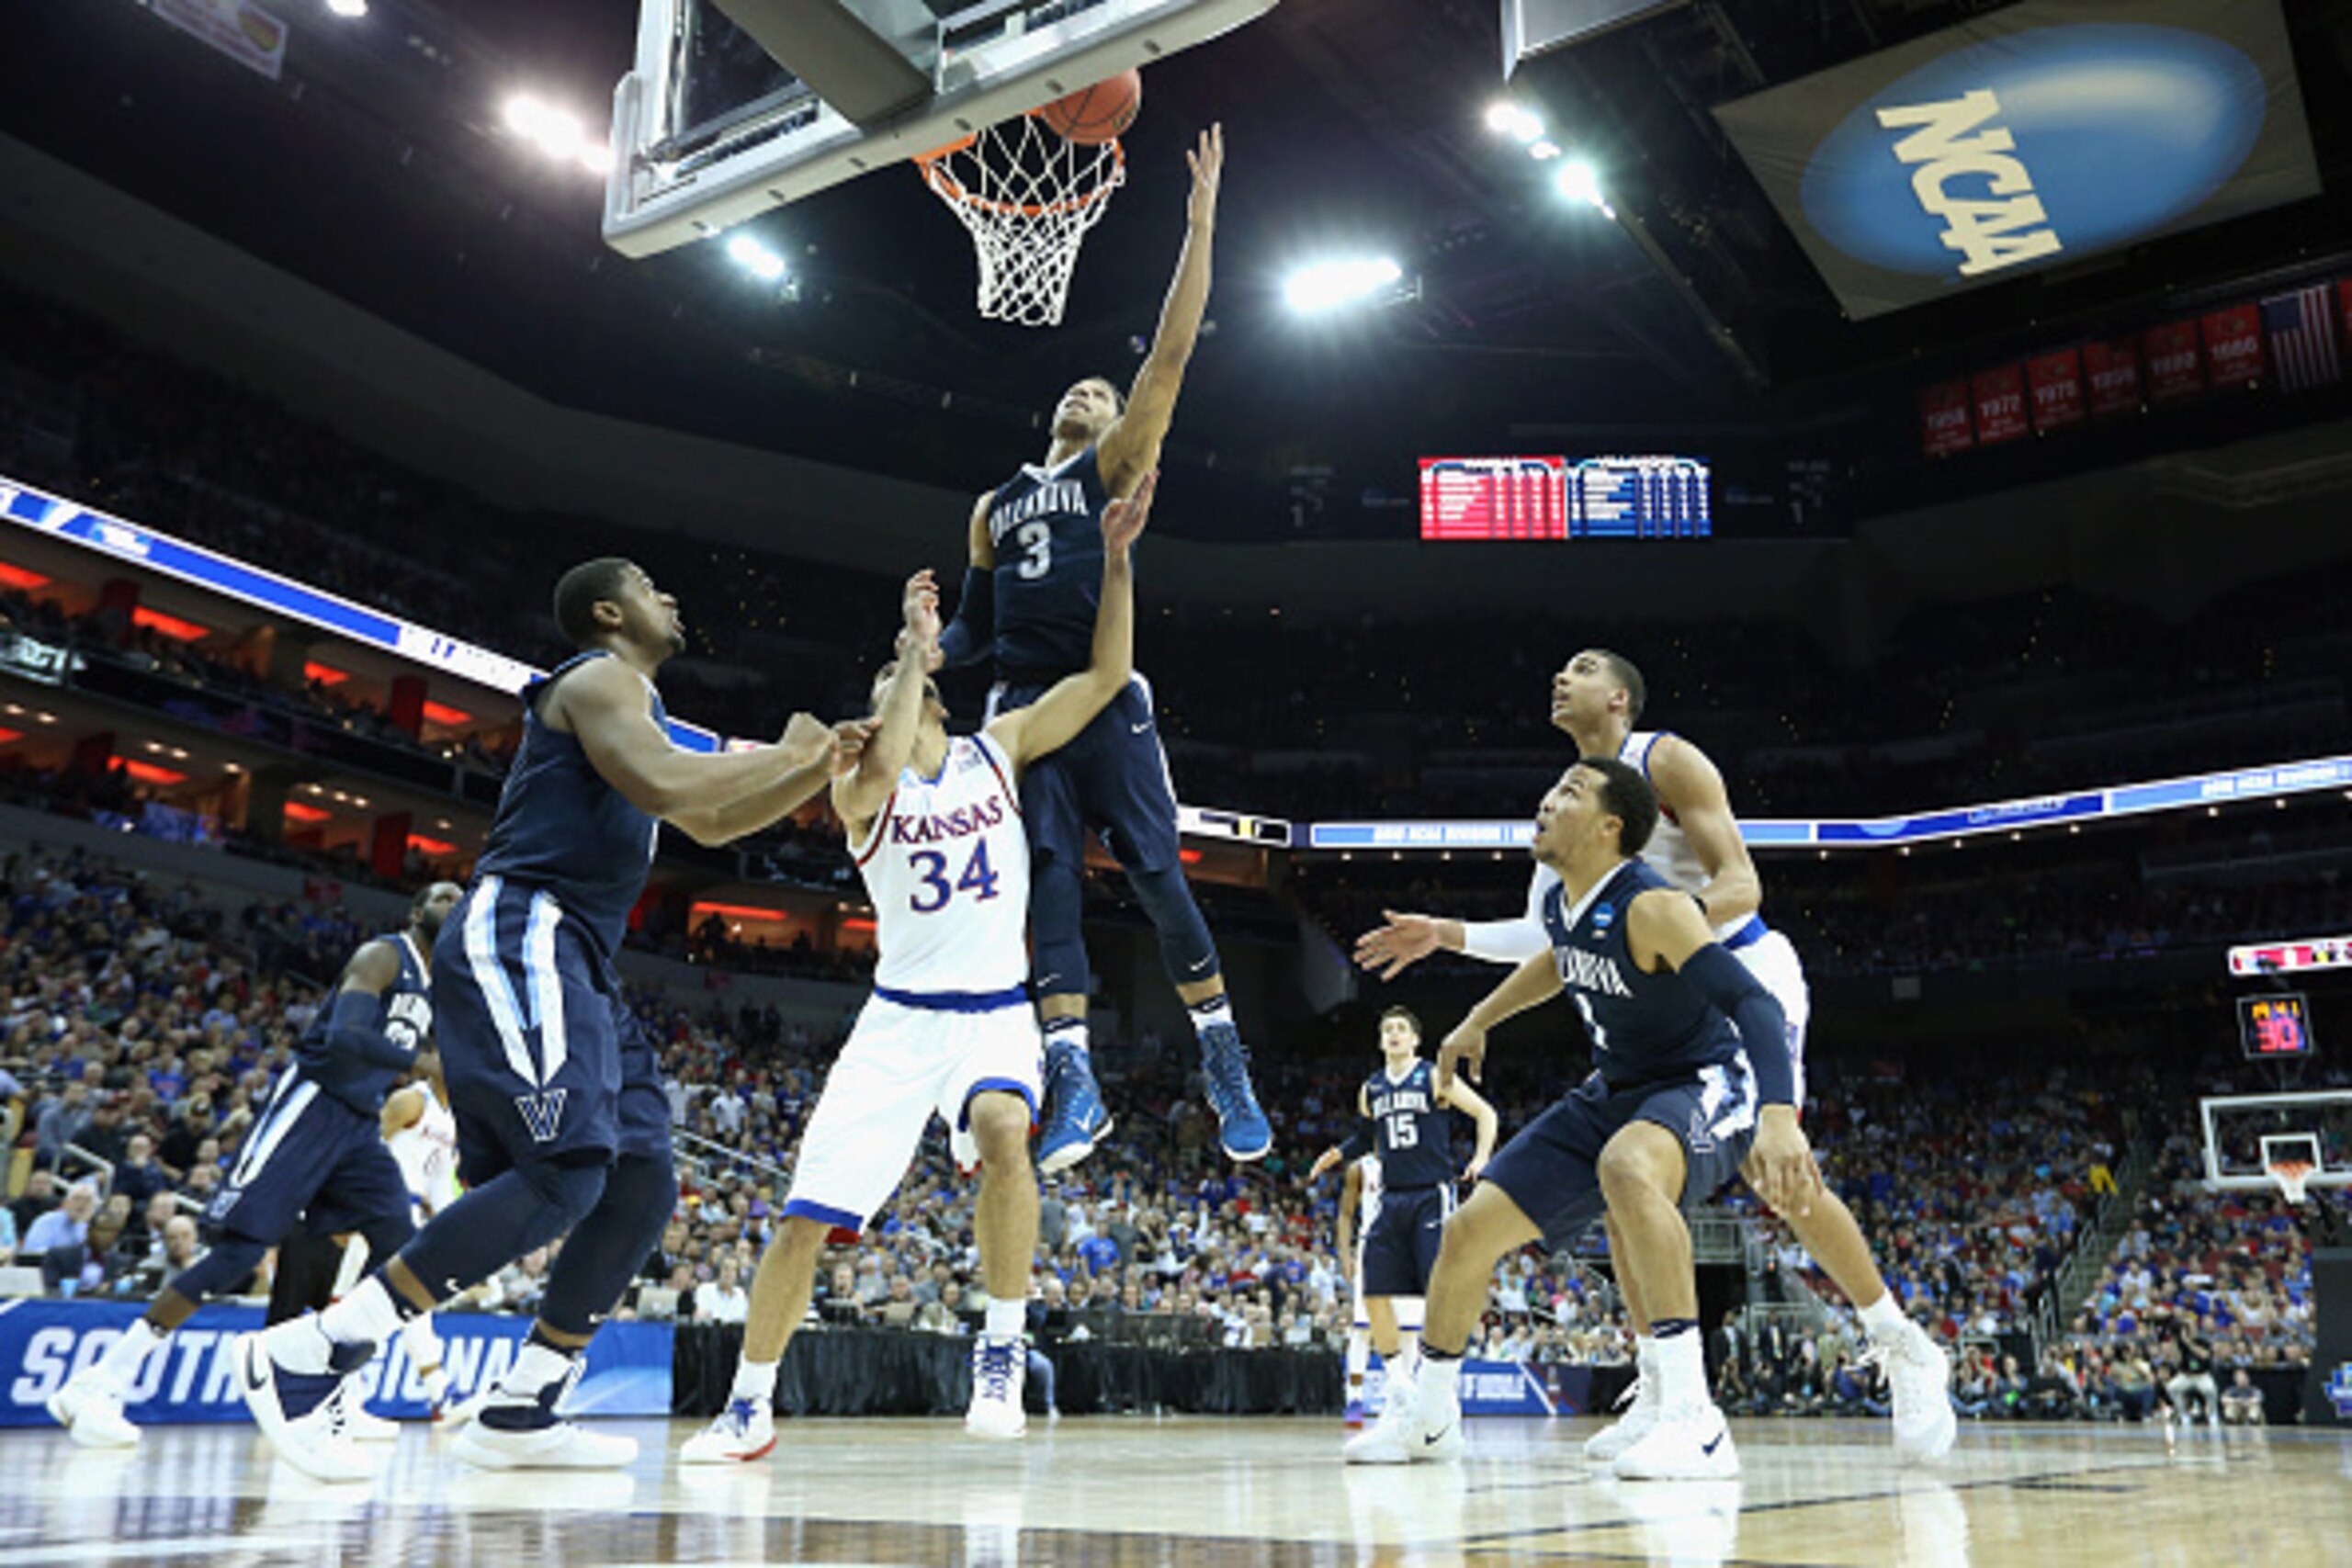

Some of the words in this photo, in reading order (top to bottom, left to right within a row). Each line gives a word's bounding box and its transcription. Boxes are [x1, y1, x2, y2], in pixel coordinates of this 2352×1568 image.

[1876, 87, 2064, 275] NCAA
[1017, 519, 1051, 580] 3
[890, 795, 1002, 843] KANSAS
[910, 836, 1000, 914] 34
[1385, 1113, 1419, 1150] 15
